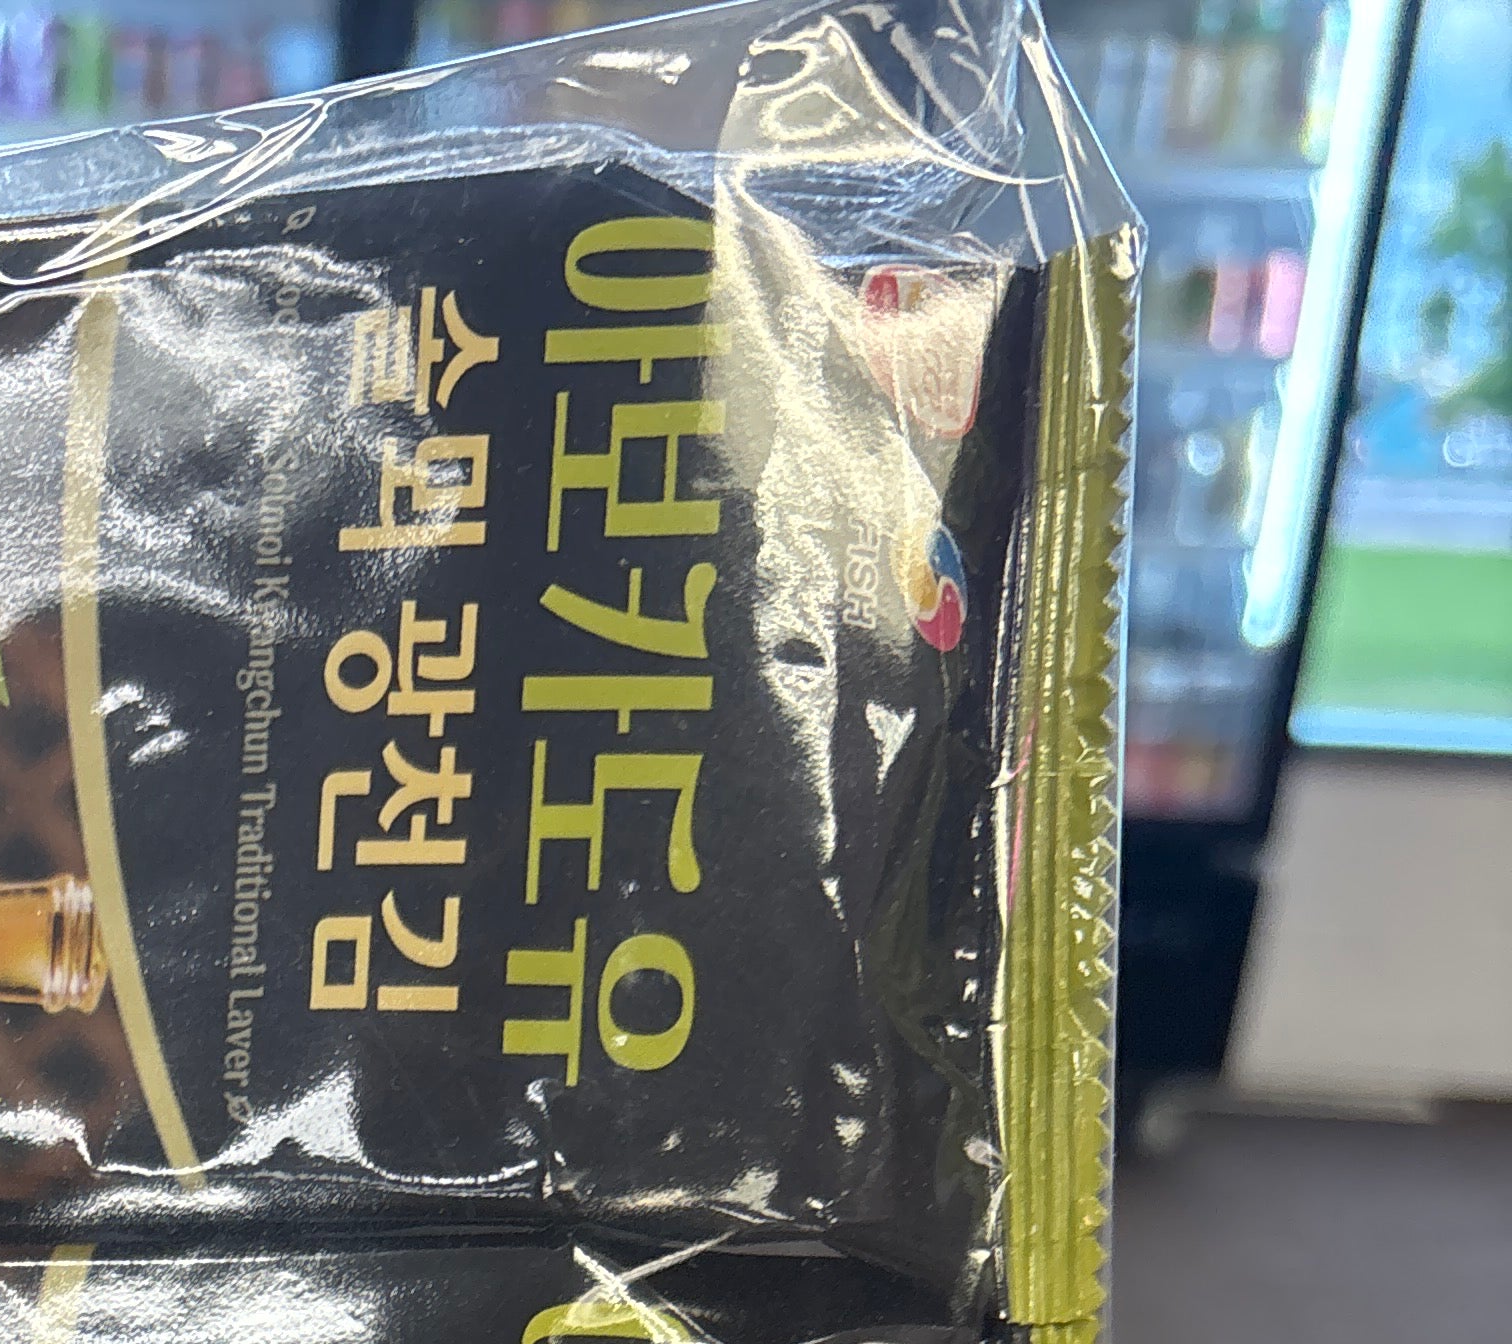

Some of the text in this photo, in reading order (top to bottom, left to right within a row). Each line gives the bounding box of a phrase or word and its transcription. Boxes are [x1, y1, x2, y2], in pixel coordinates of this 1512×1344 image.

[502, 216, 730, 1087] 아보카도유
[227, 783, 278, 980] Traditional
[308, 599, 479, 1014] 광천김
[222, 987, 265, 1087] Laver
